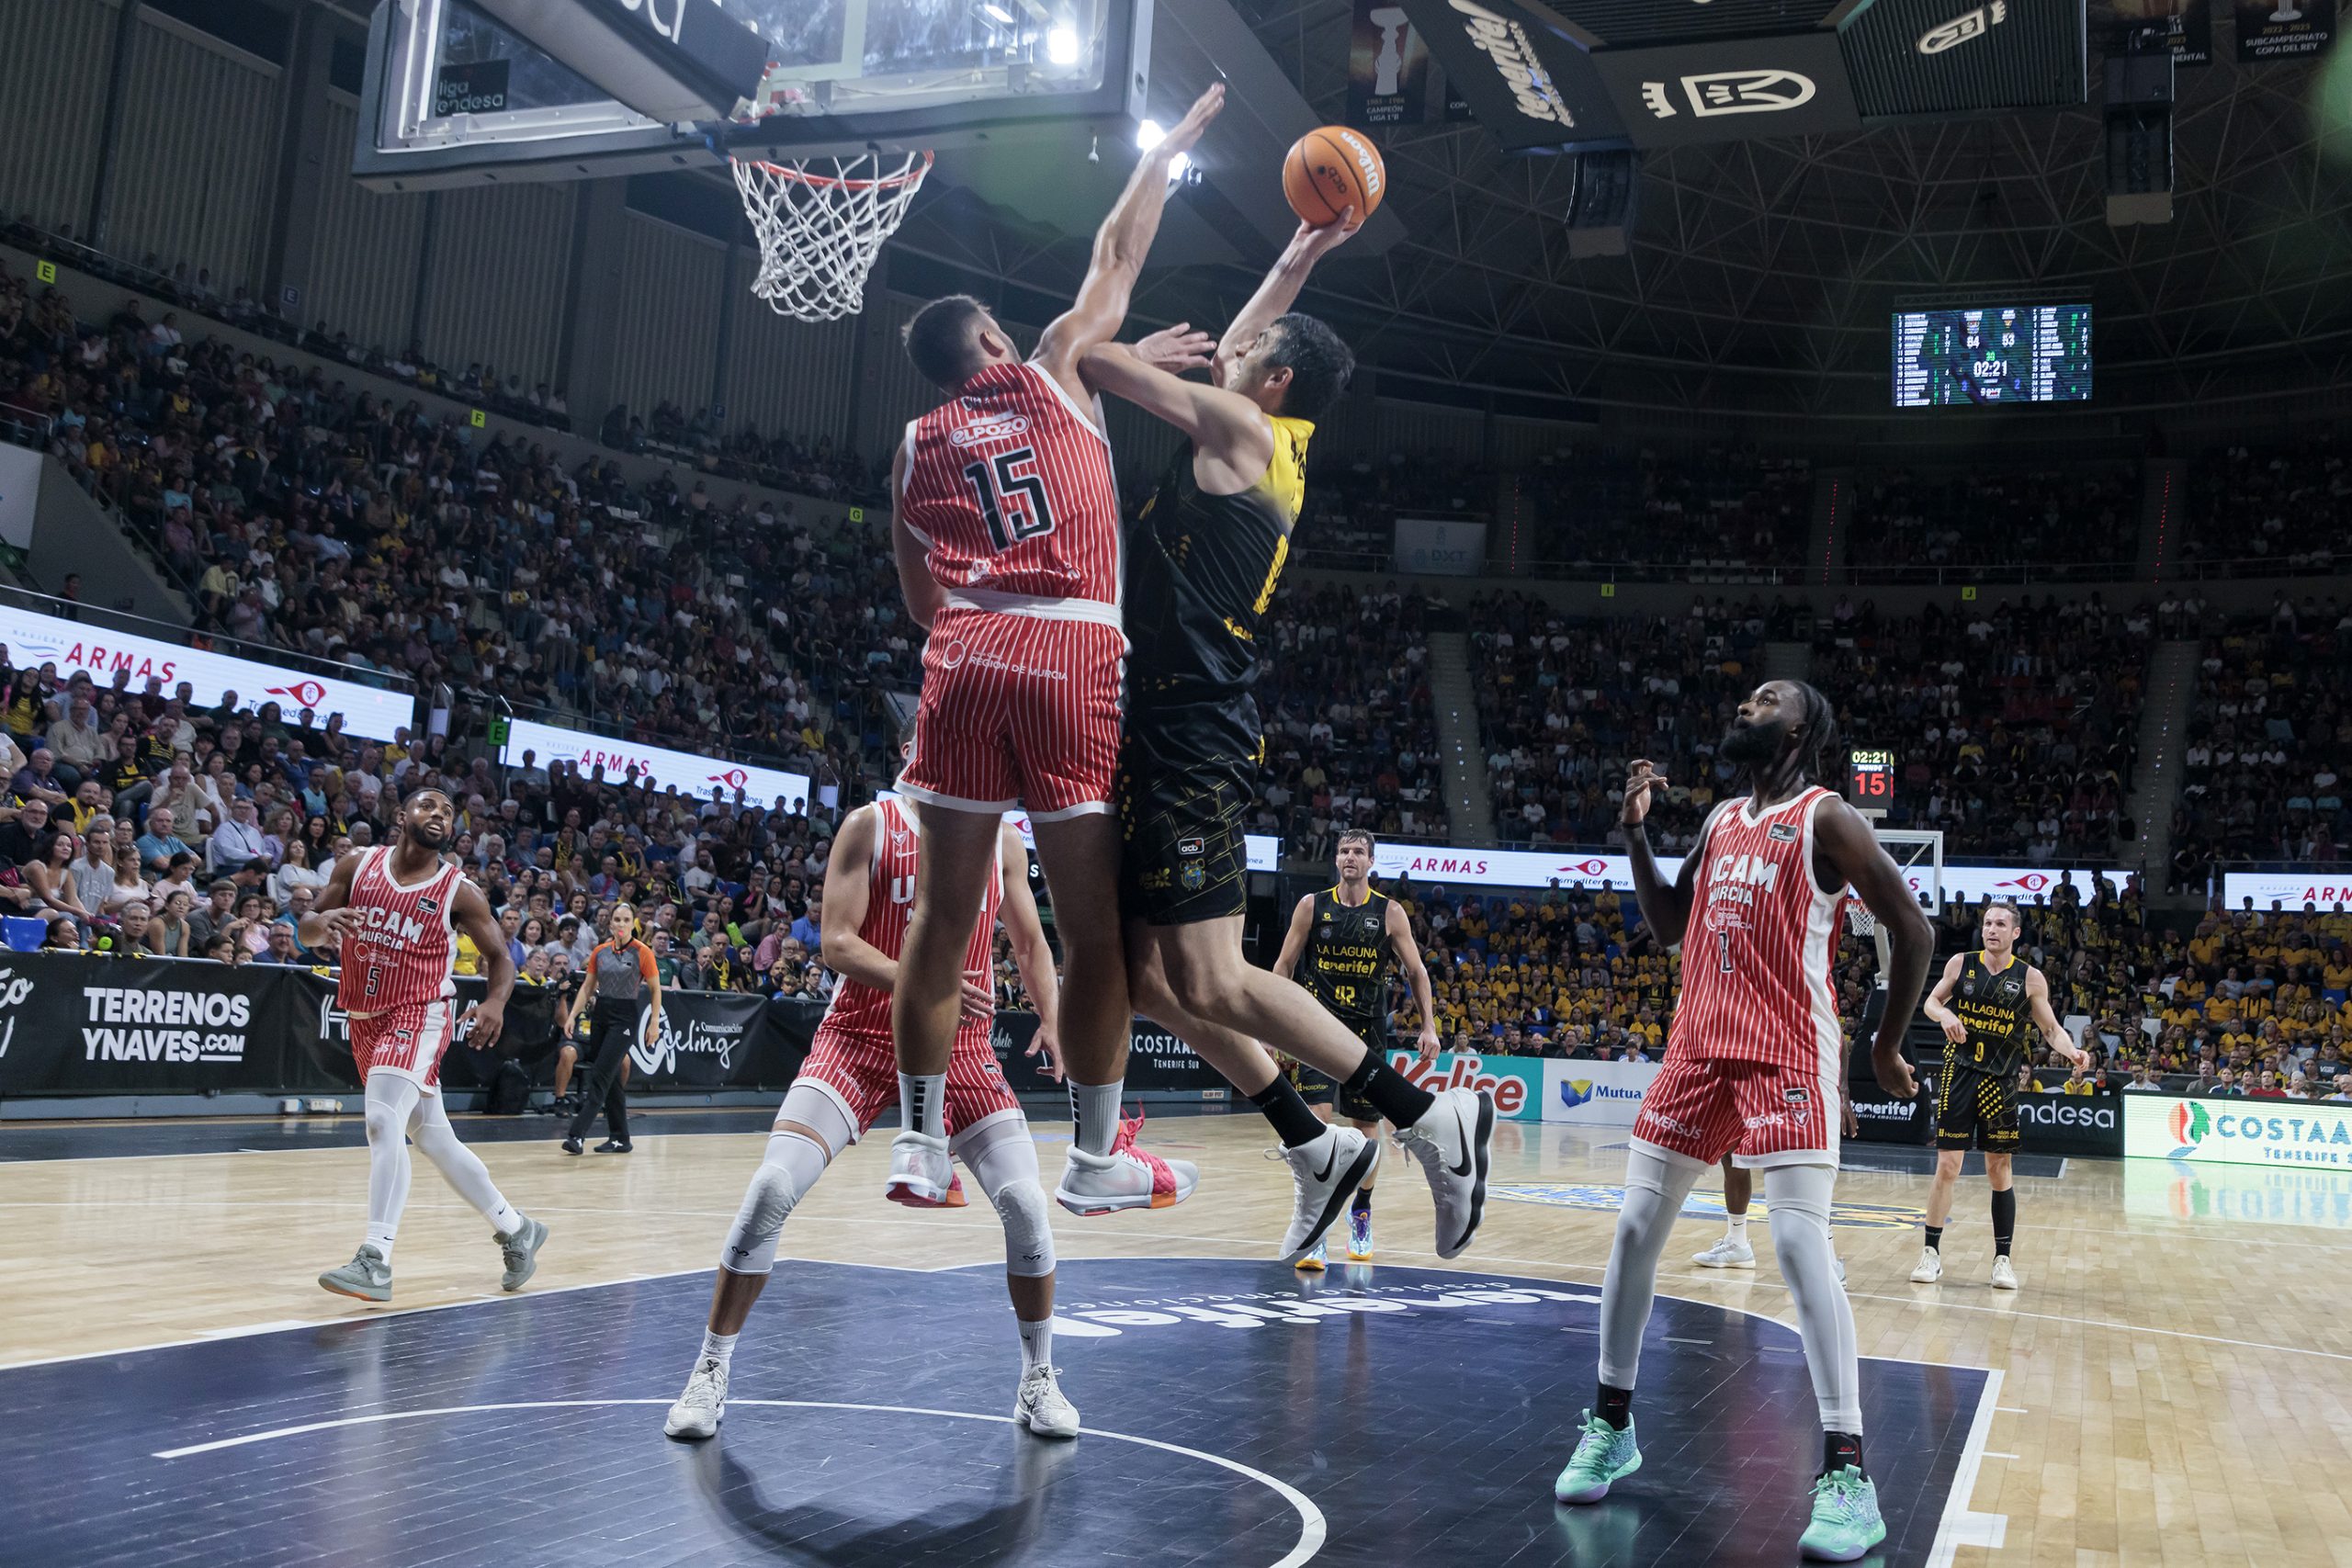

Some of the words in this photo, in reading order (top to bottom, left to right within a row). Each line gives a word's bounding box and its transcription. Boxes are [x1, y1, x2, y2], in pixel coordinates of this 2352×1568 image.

[2246, 32, 2328, 47] SUBCAMPEONATO
[2256, 46, 2281, 55] COPA
[2283, 44, 2300, 52] DEL
[2301, 42, 2318, 51] REY
[439, 79, 469, 98] liga
[437, 94, 504, 113] endesa
[1367, 106, 1403, 114] CAMPEÓN
[43, 265, 52, 279] E
[287, 289, 295, 302] E
[1973, 362, 2007, 378] 02:21
[475, 412, 482, 423] F
[966, 446, 1056, 551] 15
[64, 642, 176, 683] ARMAS
[1029, 668, 1068, 681] MURCIA
[494, 726, 503, 740] E
[1852, 751, 1887, 763] 02:21
[1855, 773, 1885, 795] 15
[1410, 857, 1487, 874] ARMAS
[358, 931, 404, 951] MURCIA
[1317, 944, 1330, 954] LA
[1332, 946, 1377, 959] LAGUNA
[366, 966, 382, 997] 5
[1335, 986, 1356, 1007] 42
[84, 987, 250, 1028] TERRENOS
[1958, 998, 1971, 1010] LA
[1972, 1002, 2015, 1021] LAGUNA
[83, 1028, 244, 1062] YNAVES.COM
[1135, 1034, 1182, 1054] COSTA
[1974, 1042, 1984, 1063] 9
[1596, 1086, 1642, 1100] Mutua
[2018, 1100, 2114, 1129] ndesa
[2217, 1114, 2326, 1144] COSTA
[2264, 1146, 2337, 1164] TENERIFE
[1316, 1281, 1510, 1296] despierta
